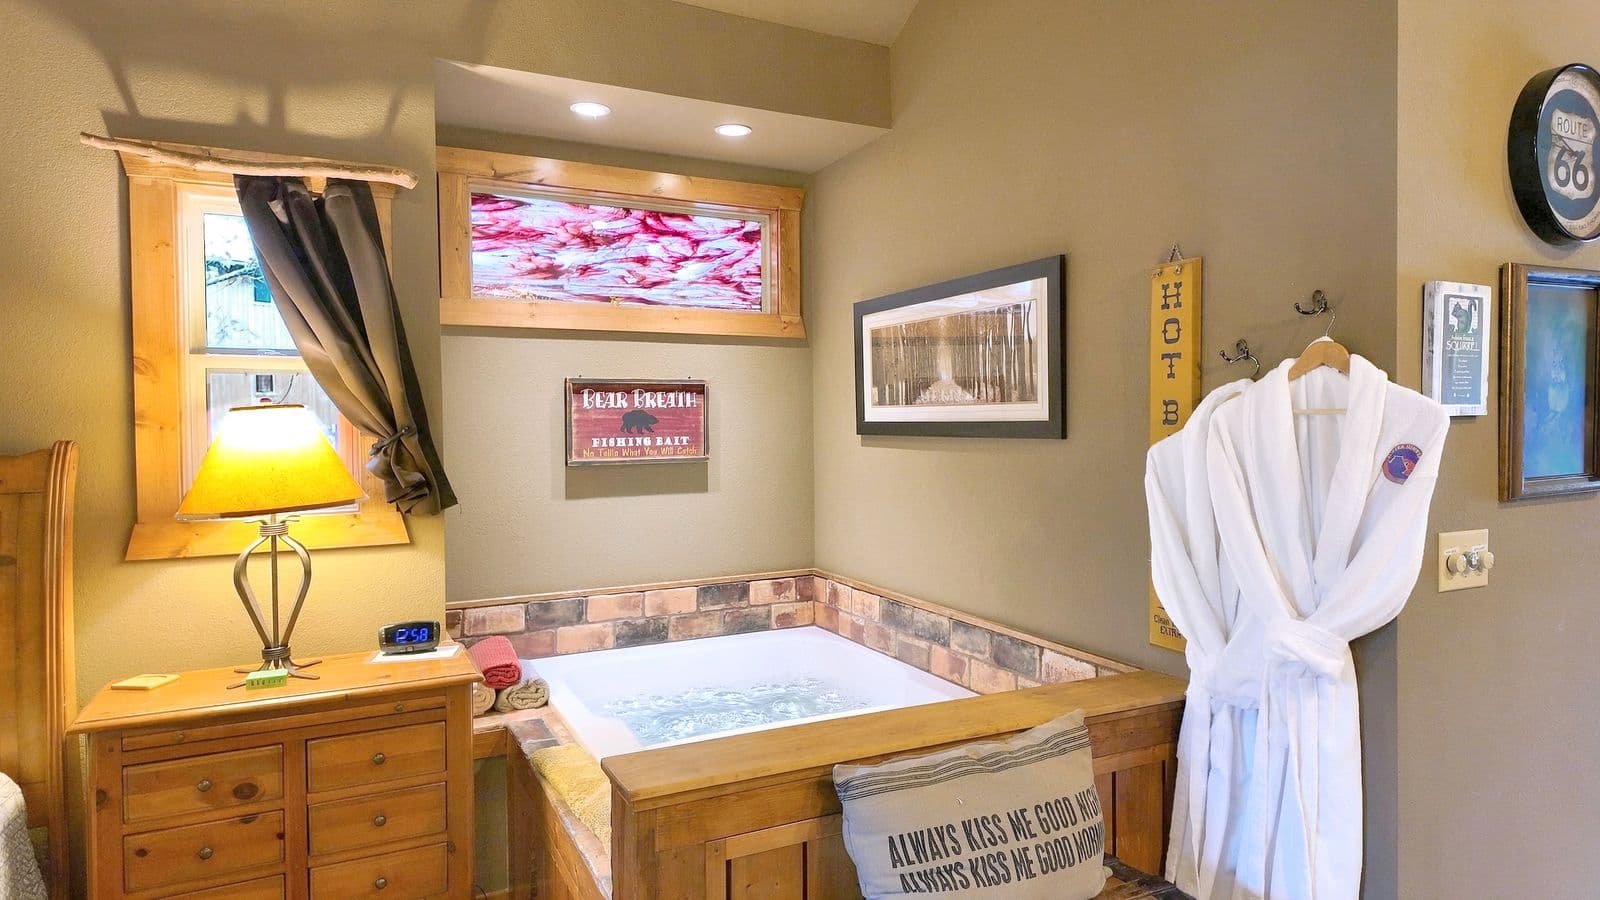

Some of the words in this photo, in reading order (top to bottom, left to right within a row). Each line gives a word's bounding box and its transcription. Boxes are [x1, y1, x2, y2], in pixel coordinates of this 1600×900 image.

[1557, 117, 1588, 138] ROUTE
[1554, 147, 1589, 191] 66
[1161, 281, 1182, 379] HOT
[581, 388, 628, 409] BEAR
[631, 388, 697, 409] BREATH
[583, 448, 594, 458] No
[622, 448, 641, 457] What
[644, 447, 657, 456] You
[661, 446, 674, 455] Will
[677, 445, 697, 455] Catch
[592, 437, 651, 448] FISHING
[656, 436, 689, 446] BAIT
[888, 824, 961, 868] ALWAYS
[961, 813, 1008, 852] KISS
[1006, 808, 1037, 842] ME
[1034, 796, 1077, 835] GOOD
[1074, 783, 1101, 822] NIG
[899, 861, 970, 894] ALWAYS
[968, 851, 1011, 888] KISS
[1010, 846, 1037, 882] ME
[1035, 836, 1075, 875] GOOD
